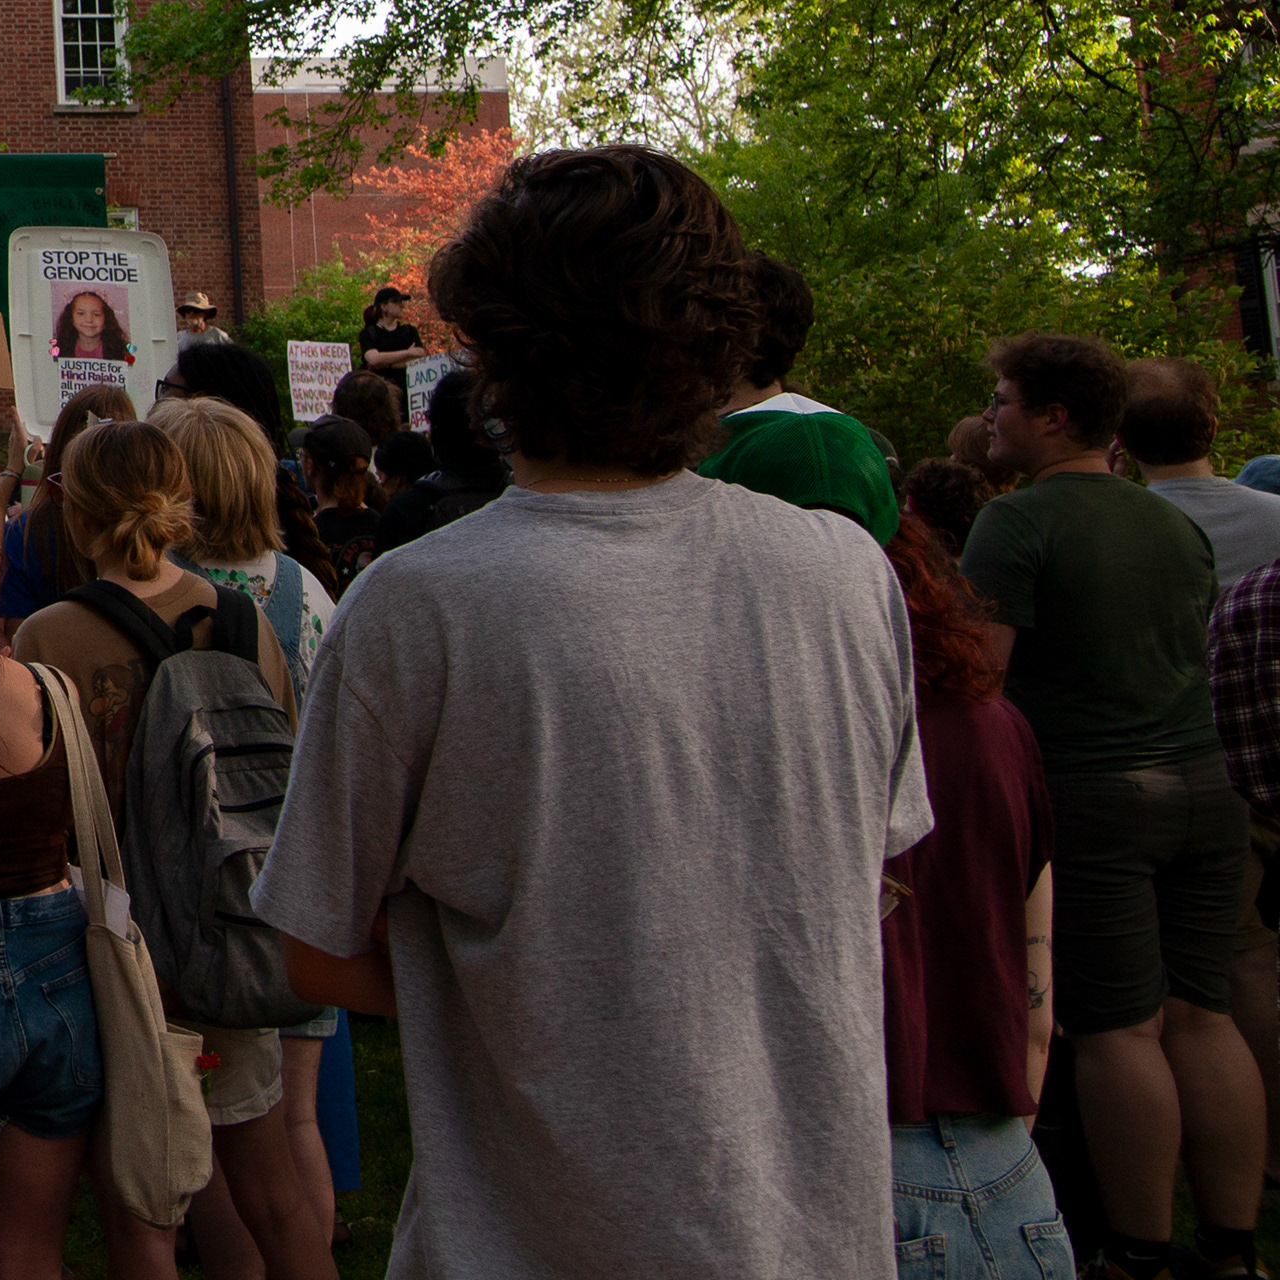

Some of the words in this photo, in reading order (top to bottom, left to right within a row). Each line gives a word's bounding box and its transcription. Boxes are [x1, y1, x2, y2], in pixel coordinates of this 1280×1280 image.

[42, 251, 90, 265] STOP
[91, 252, 129, 266] THE
[43, 266, 138, 282] GENOCIDE
[289, 345, 319, 358] ATHENS
[319, 345, 348, 358] NEEDS
[60, 360, 107, 372] JUSTICE
[107, 363, 122, 373] for
[289, 359, 350, 374] TRANSPARENCY
[61, 370, 86, 381] Hind
[88, 372, 117, 385] Rajab
[118, 374, 126, 384] &
[290, 372, 314, 385] FROM
[407, 368, 438, 388] LAND
[60, 381, 73, 390] all
